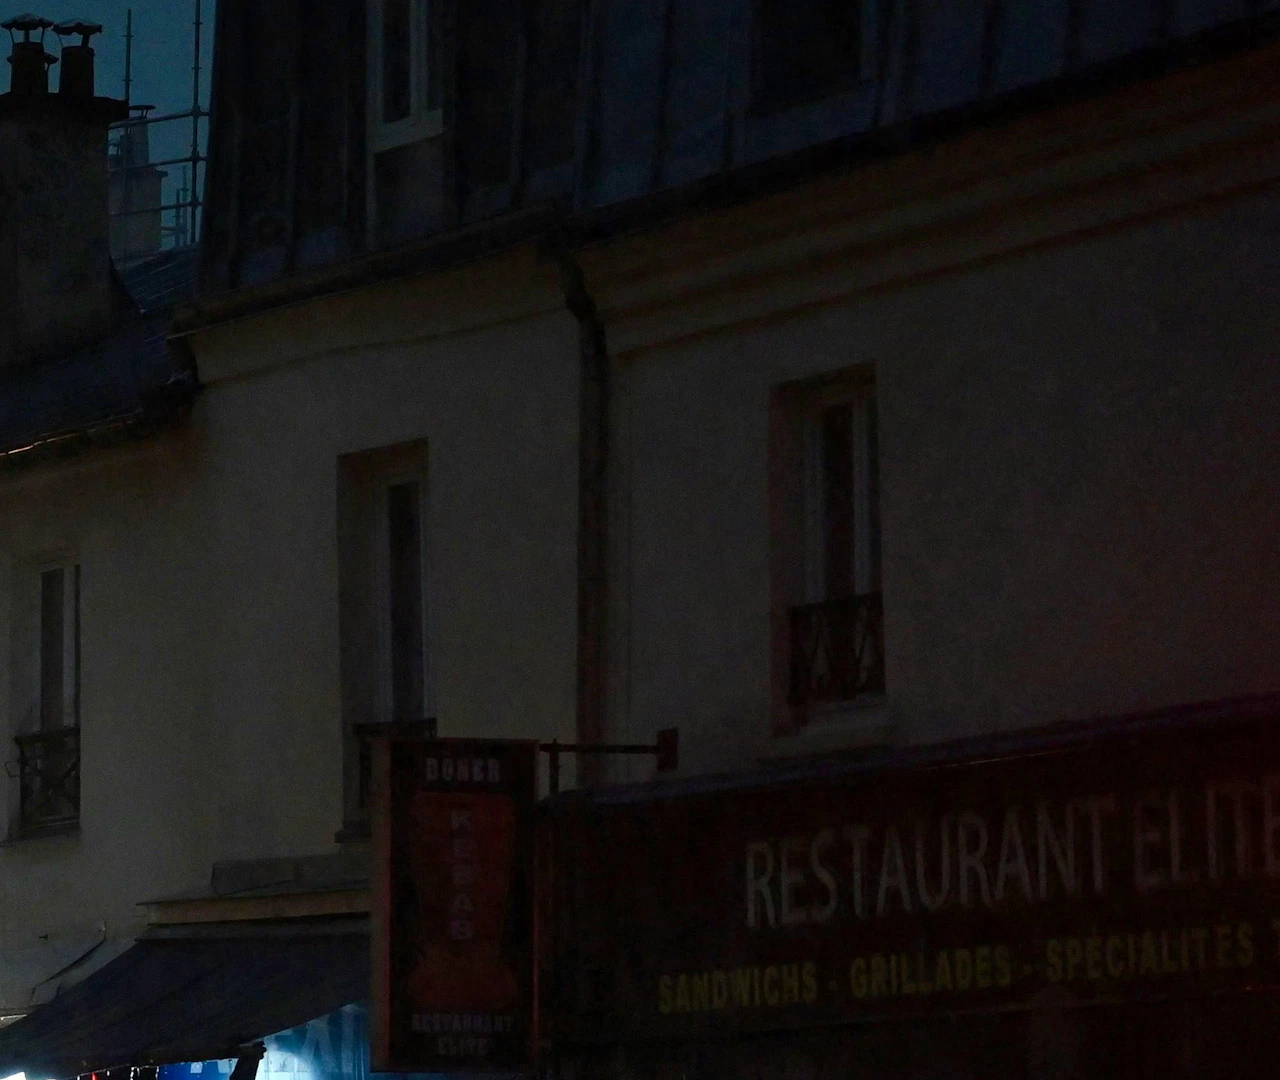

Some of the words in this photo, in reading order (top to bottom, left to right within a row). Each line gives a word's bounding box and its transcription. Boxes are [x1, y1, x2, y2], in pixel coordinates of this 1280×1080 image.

[450, 809, 476, 941] KEBAB
[745, 794, 1116, 931] RESTAURANT
[658, 960, 819, 1015] SANDWICHS
[849, 945, 1011, 999] GRILLADES
